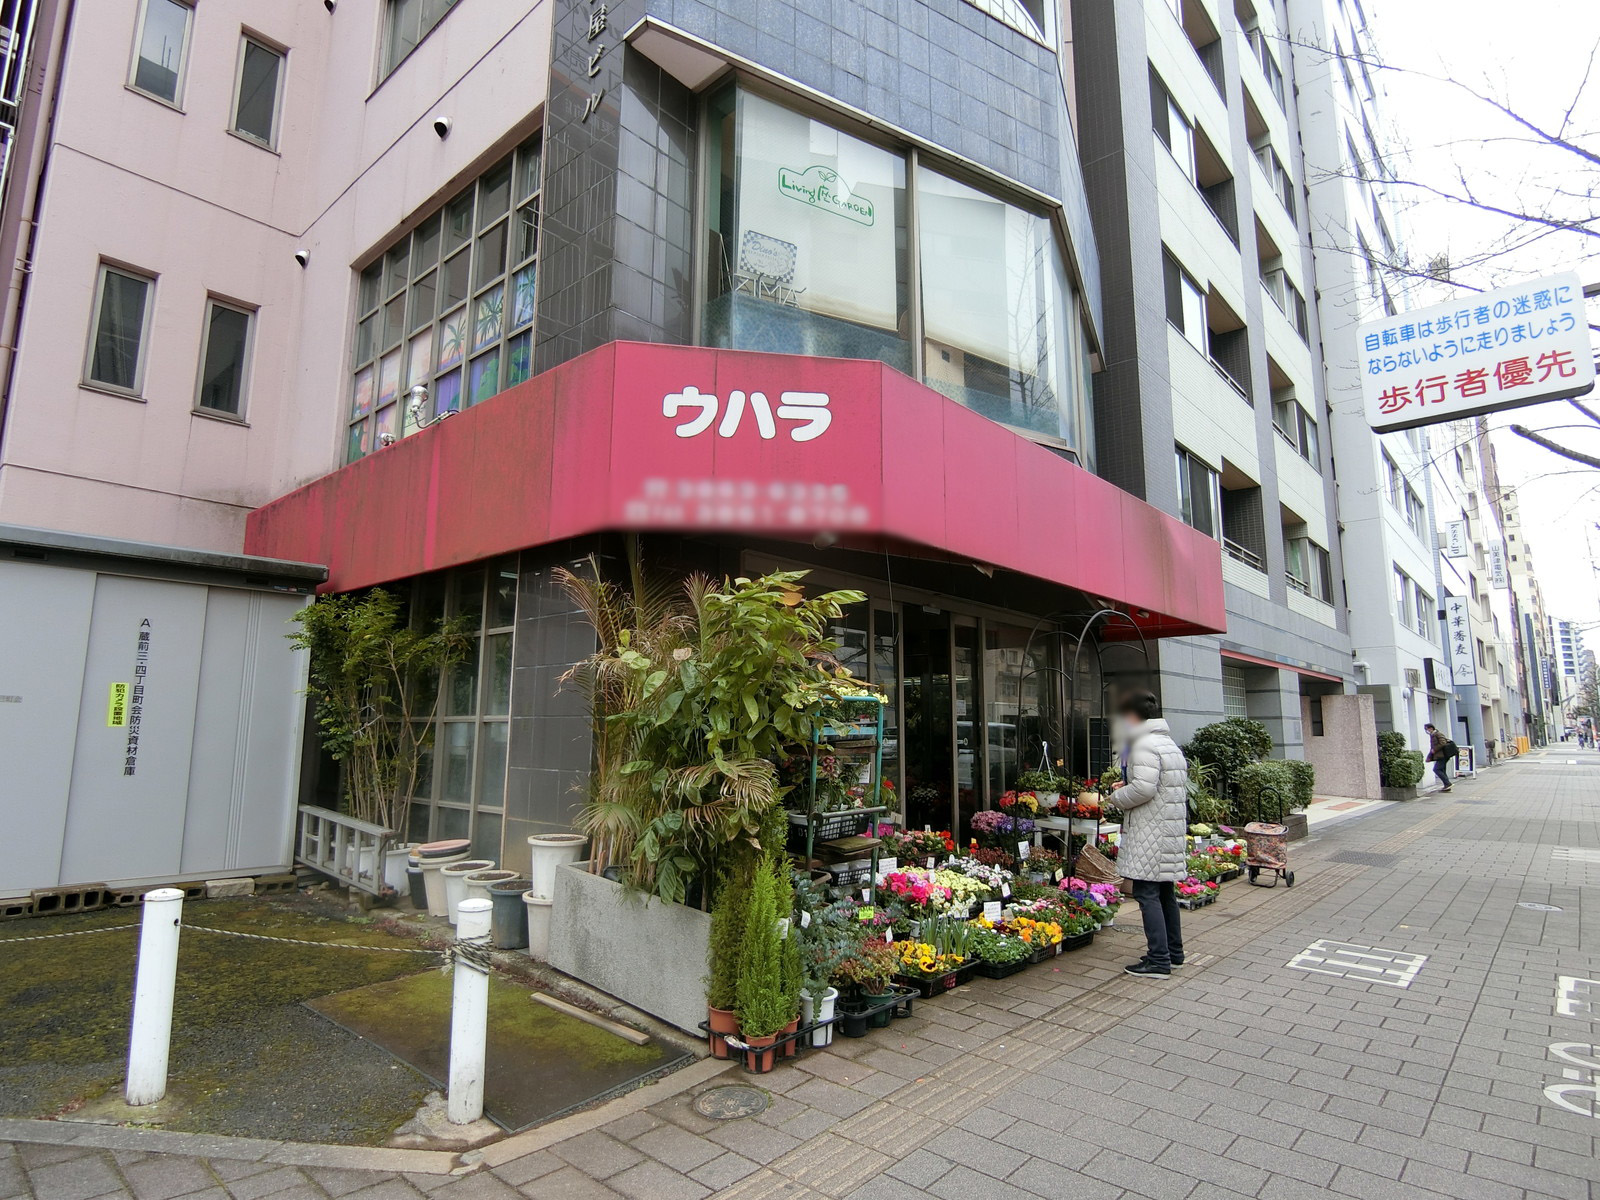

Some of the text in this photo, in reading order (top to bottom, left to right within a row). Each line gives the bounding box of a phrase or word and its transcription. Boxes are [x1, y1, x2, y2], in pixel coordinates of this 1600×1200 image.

[581, 0, 607, 124] 屋ビル
[1364, 285, 1573, 352] 自転車は歩行者の迷惑に
[1367, 312, 1576, 375] ならないように走りましょう
[662, 386, 832, 442] ウハラ
[1378, 349, 1577, 415] 歩行者優先
[1450, 602, 1468, 656] 中華蕎麦
